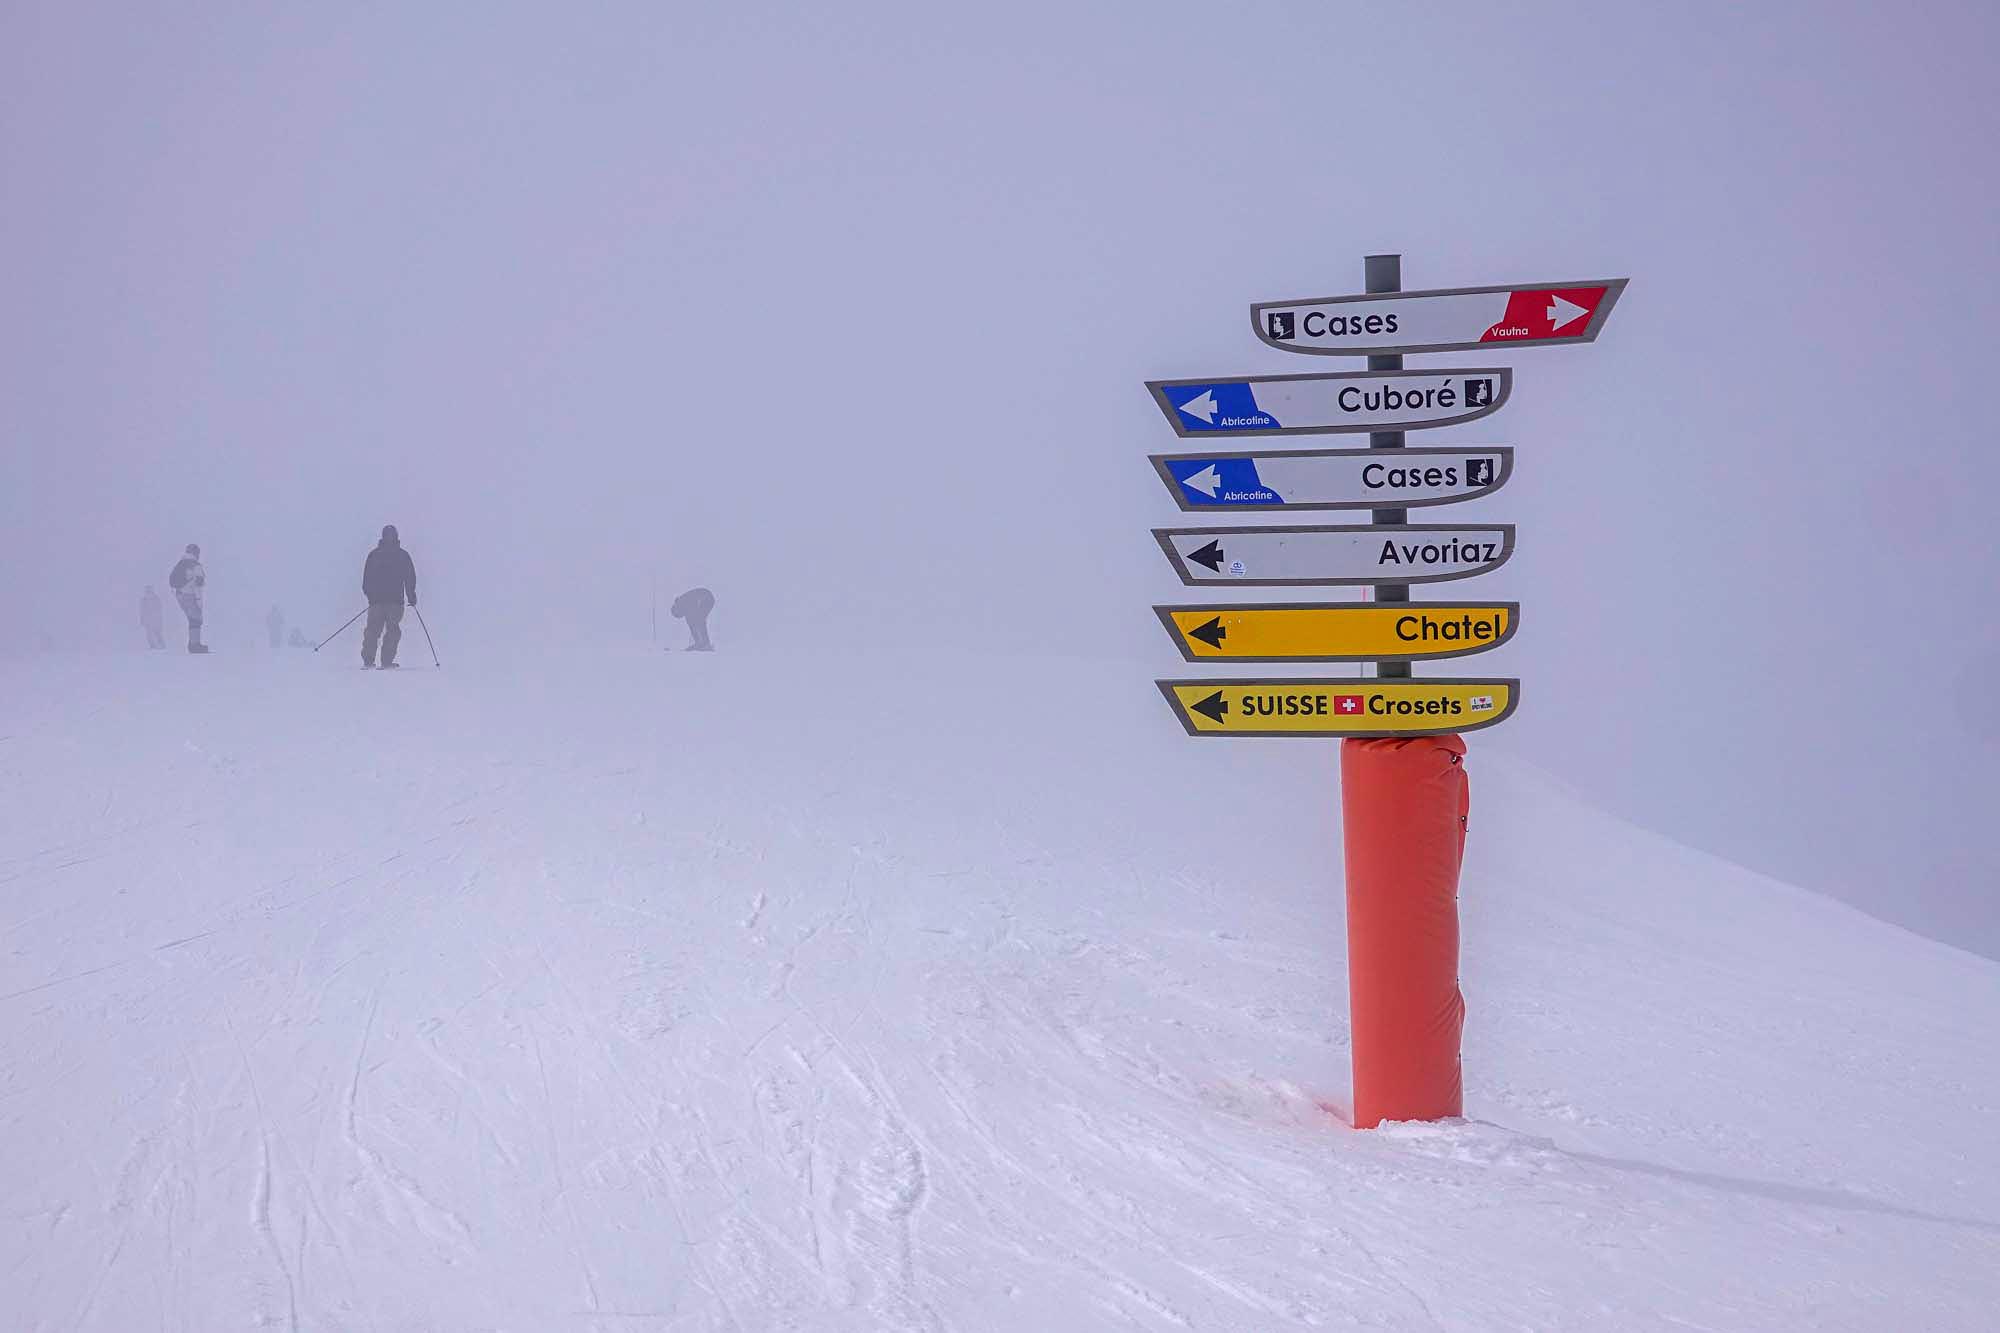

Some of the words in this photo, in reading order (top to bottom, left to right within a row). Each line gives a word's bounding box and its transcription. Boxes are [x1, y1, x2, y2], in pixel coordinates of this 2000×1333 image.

[1303, 311, 1398, 338] Cases
[1338, 378, 1457, 412] Cuboré
[1220, 415, 1270, 427] Abricotine
[1362, 463, 1458, 489] Cases
[1224, 491, 1273, 501] Abricotine
[1378, 537, 1497, 565] Avoriaz
[1395, 614, 1500, 642] Chatel
[1242, 695, 1328, 716] SUISSE
[1368, 694, 1462, 716] Crosets
